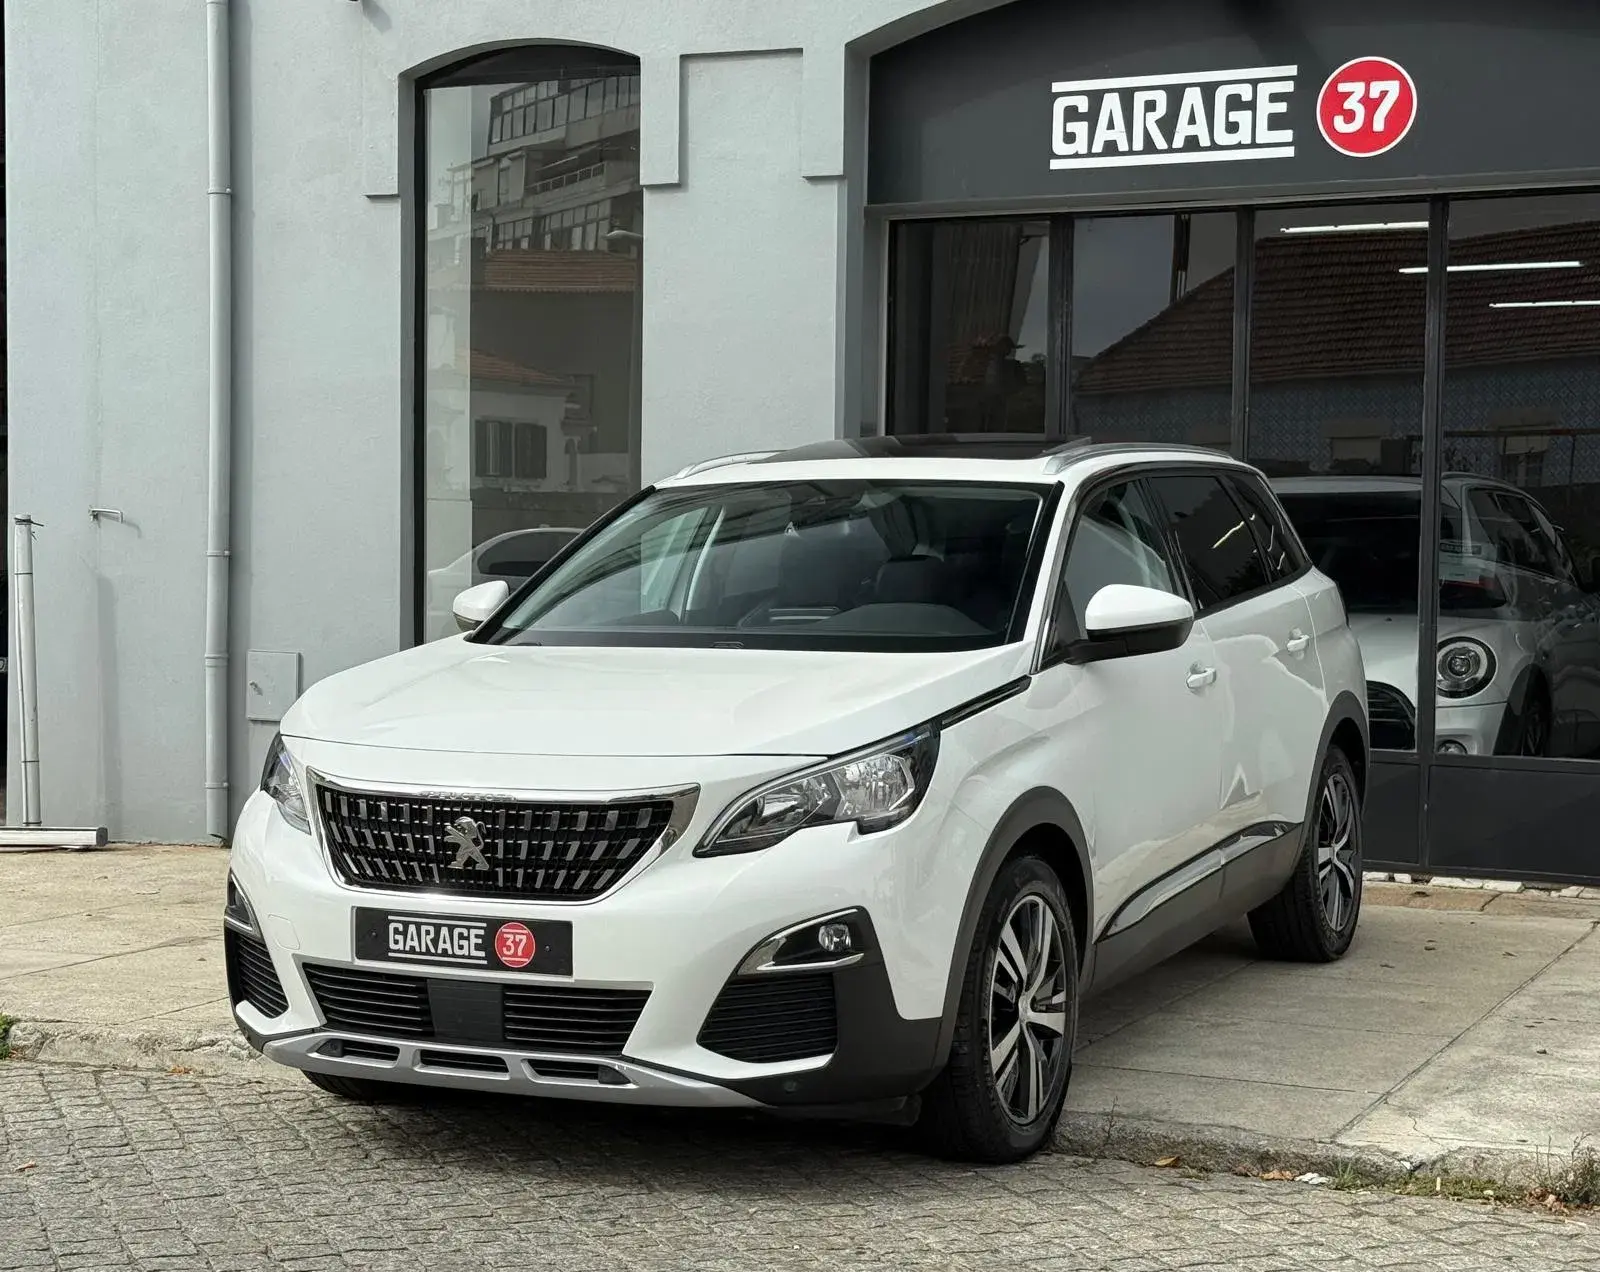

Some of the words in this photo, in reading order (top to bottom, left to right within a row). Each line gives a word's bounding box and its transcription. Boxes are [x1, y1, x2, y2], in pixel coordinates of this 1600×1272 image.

[1052, 80, 1295, 156] GARAGE
[1332, 80, 1401, 134] 37
[388, 922, 486, 957] GARAGE
[502, 933, 528, 956] 37
